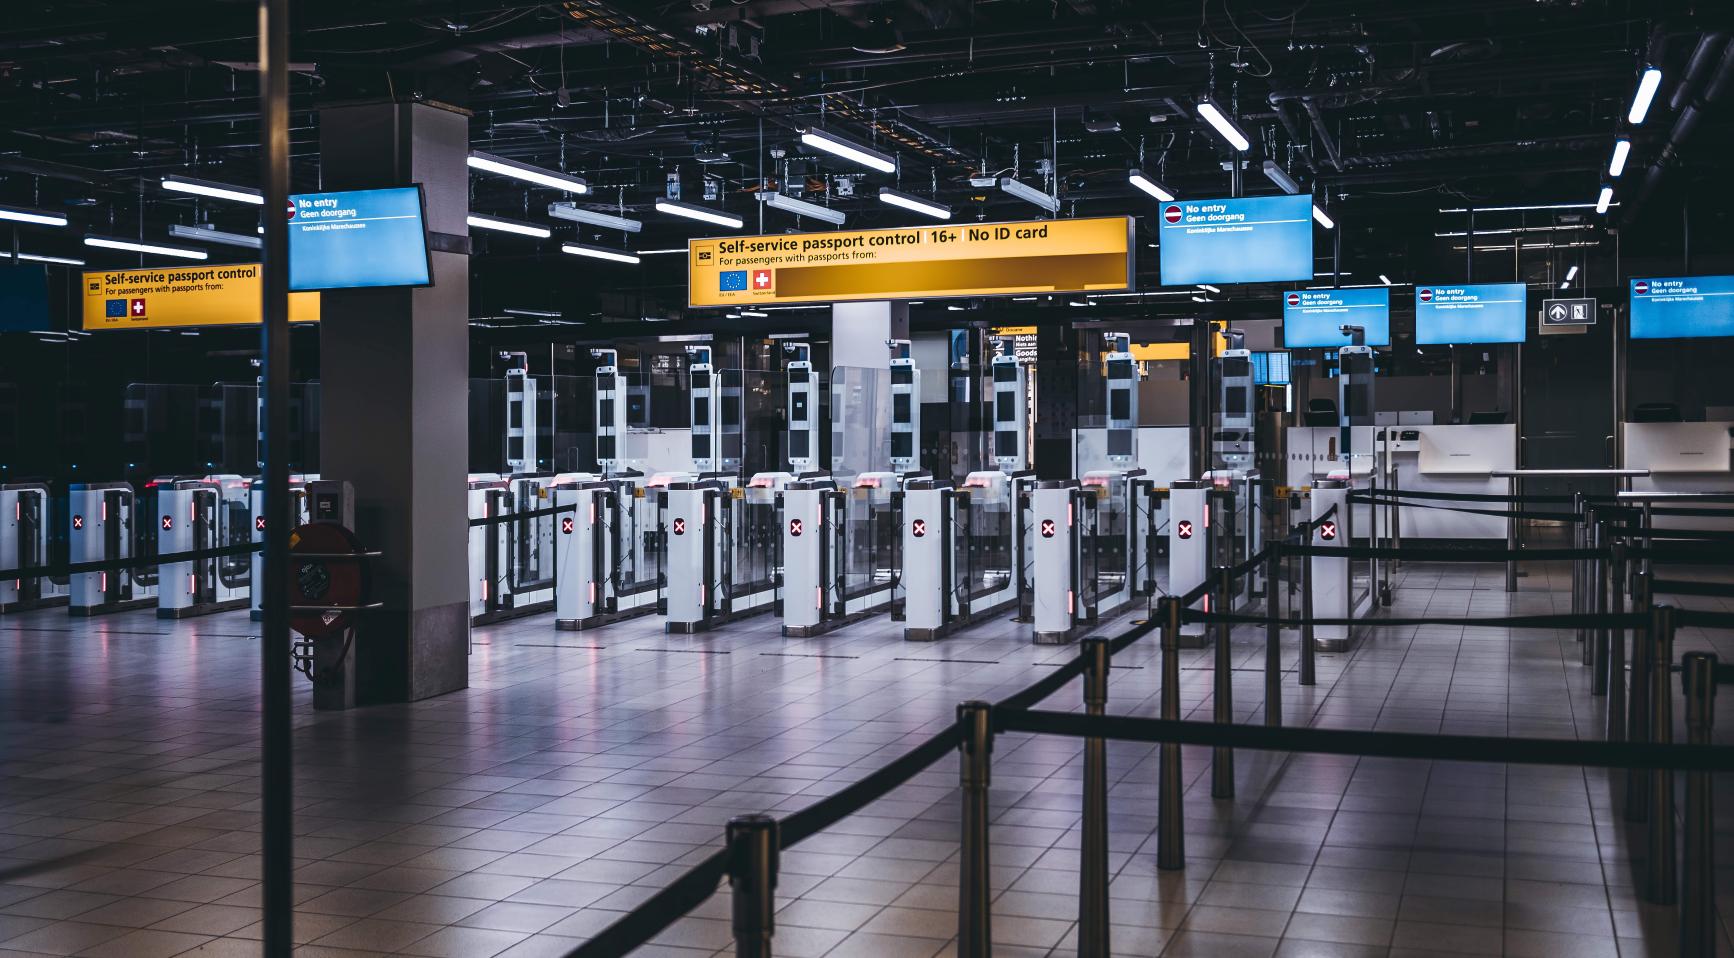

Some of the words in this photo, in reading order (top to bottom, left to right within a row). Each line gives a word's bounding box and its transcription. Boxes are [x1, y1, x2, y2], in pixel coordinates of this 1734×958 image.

[299, 199, 312, 208] No
[314, 198, 337, 208] entry
[1186, 205, 1199, 214] No
[1201, 204, 1226, 213] entry
[300, 210, 319, 218] Geen
[320, 208, 356, 218] doorgang
[1207, 213, 1245, 222] doorgang
[719, 238, 798, 254] Self-service
[802, 235, 864, 252] passport
[869, 230, 920, 247] control
[931, 230, 957, 243] 16+
[969, 228, 989, 242] No
[995, 227, 1010, 240] ID
[1015, 224, 1048, 239] card
[719, 257, 733, 266] For
[735, 254, 783, 266] passengers
[785, 252, 805, 263] with
[807, 251, 850, 263] passports
[852, 249, 877, 259] from:
[105, 271, 165, 285] Self-service
[168, 269, 214, 284] passport
[217, 266, 256, 280] control
[105, 287, 117, 295] For
[118, 284, 154, 296] passengers
[155, 283, 171, 293] with
[171, 283, 204, 294] passports
[205, 282, 224, 291] from:
